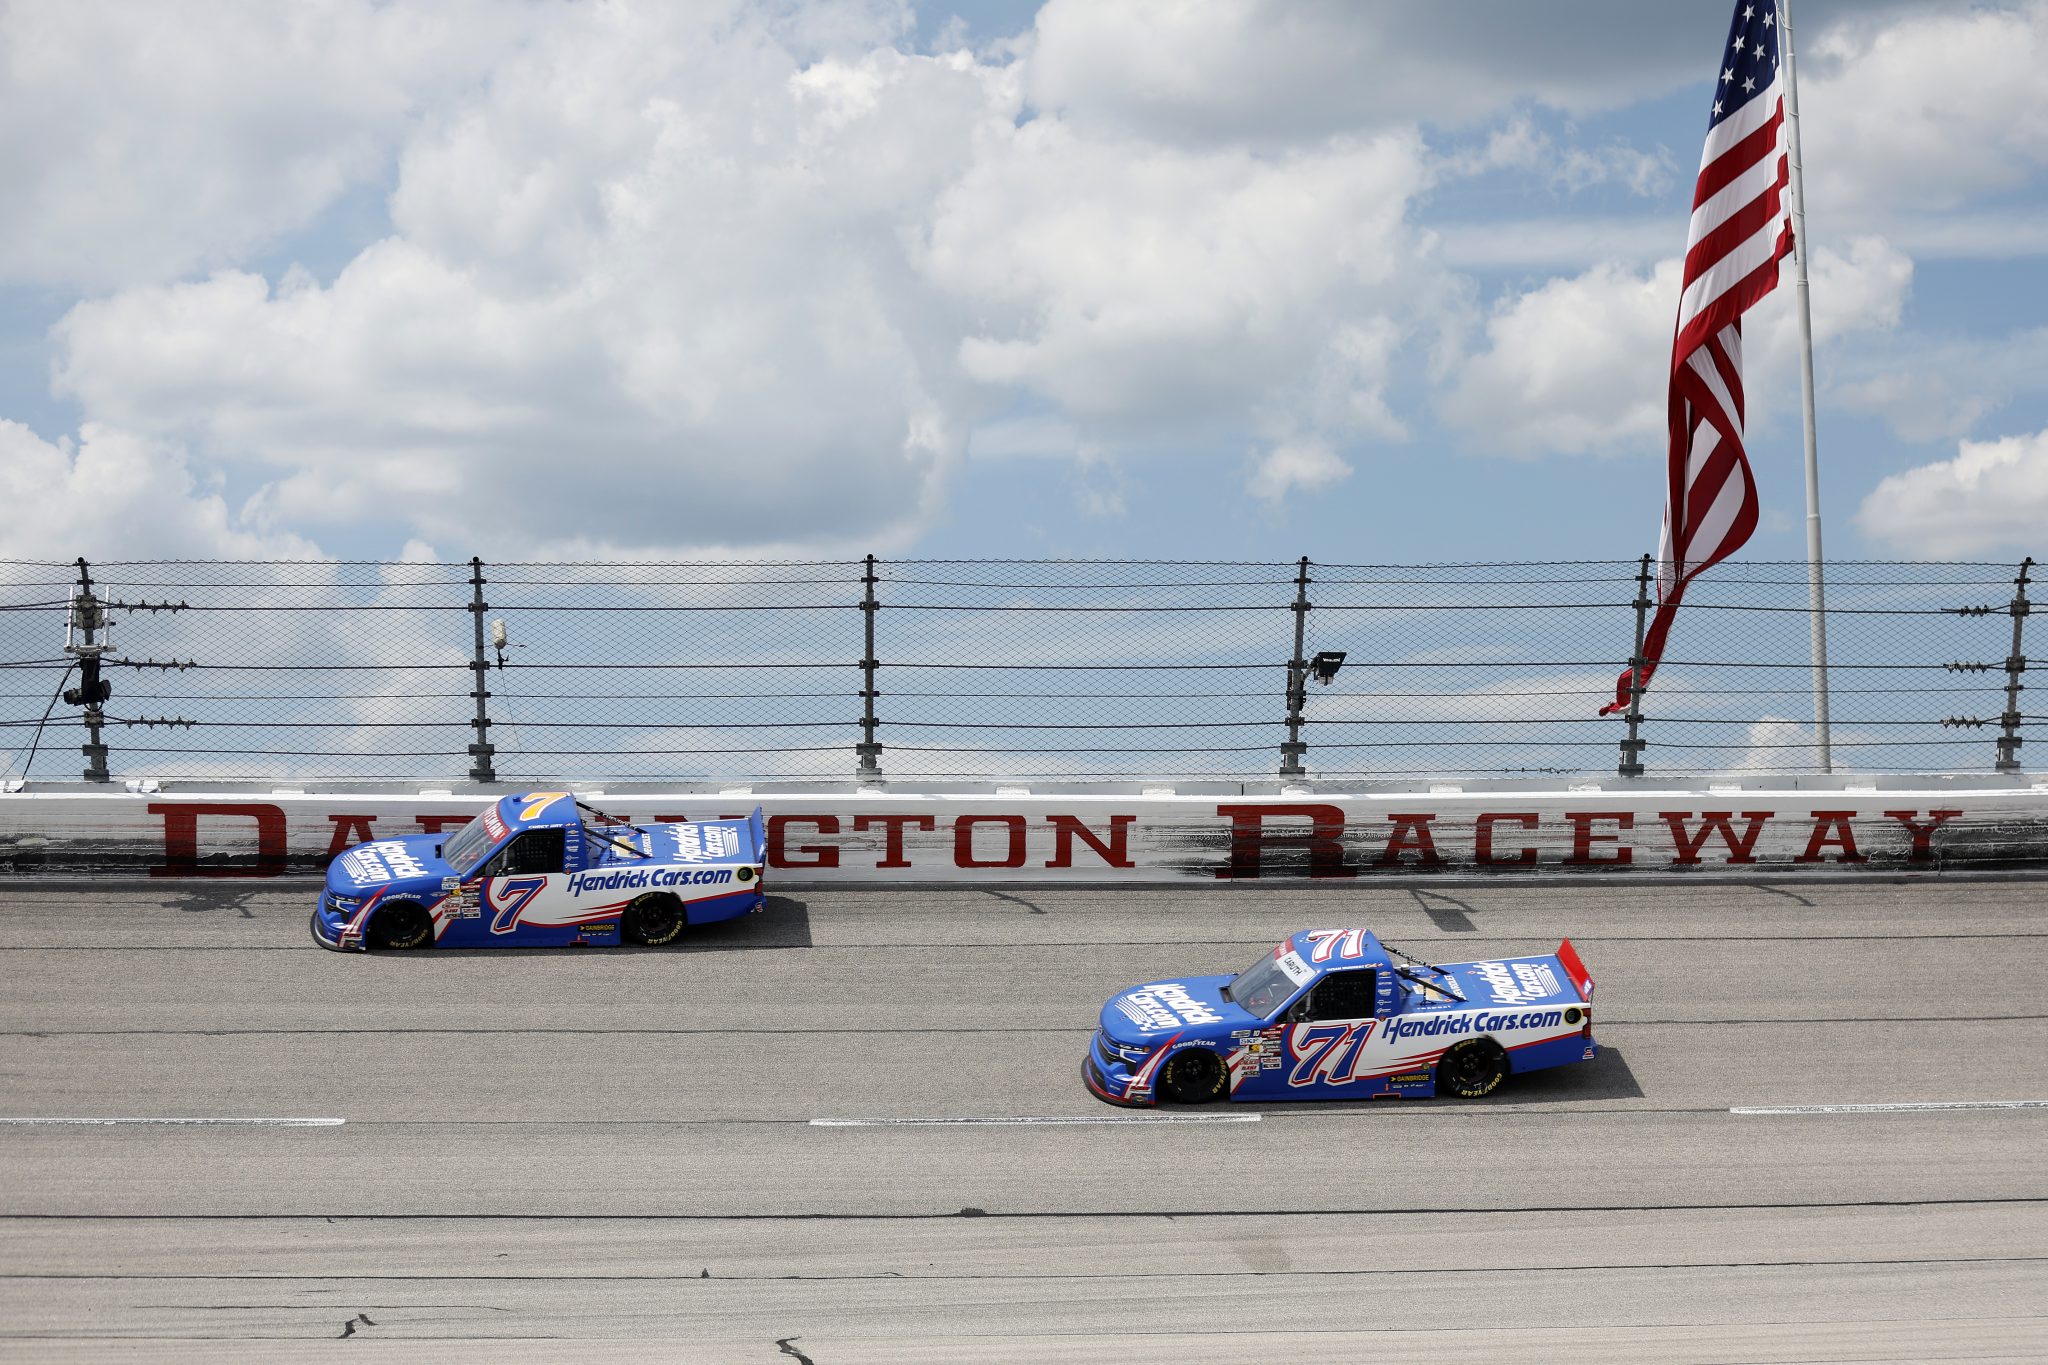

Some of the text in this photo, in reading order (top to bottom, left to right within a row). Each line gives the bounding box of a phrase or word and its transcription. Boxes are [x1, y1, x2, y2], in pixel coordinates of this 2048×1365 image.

[520, 791, 571, 822] 7
[148, 803, 1135, 878] DAGTON
[1216, 804, 1963, 878] RACEWAY
[382, 893, 422, 901] GOODYEAR
[490, 876, 548, 935] 7
[648, 920, 683, 944] GOODYEAR
[1307, 928, 1366, 963] 71
[1284, 957, 1303, 976] CARUTH
[1172, 1039, 1216, 1050] GOODYEAR
[1288, 1021, 1377, 1088] 71
[1461, 1073, 1503, 1096] GOODYEAR
